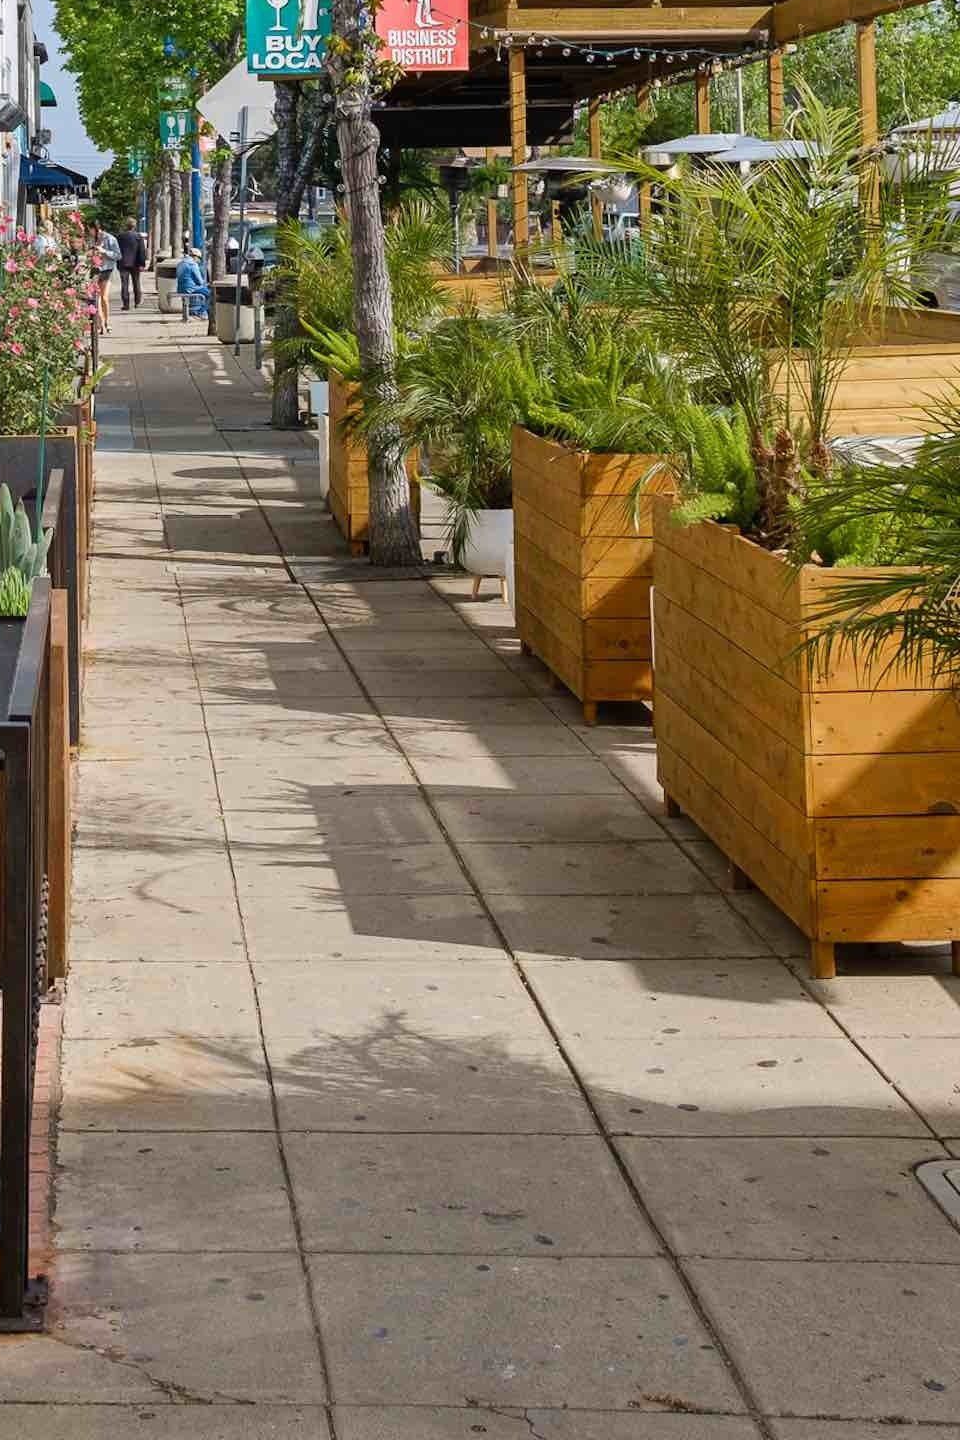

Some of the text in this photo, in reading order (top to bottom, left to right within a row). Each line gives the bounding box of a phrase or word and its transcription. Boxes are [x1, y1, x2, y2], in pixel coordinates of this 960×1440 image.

[265, 35, 322, 52] BUY
[388, 30, 456, 46] BUSINESS
[252, 53, 327, 70] LOCA
[392, 48, 454, 65] DISTRICT
